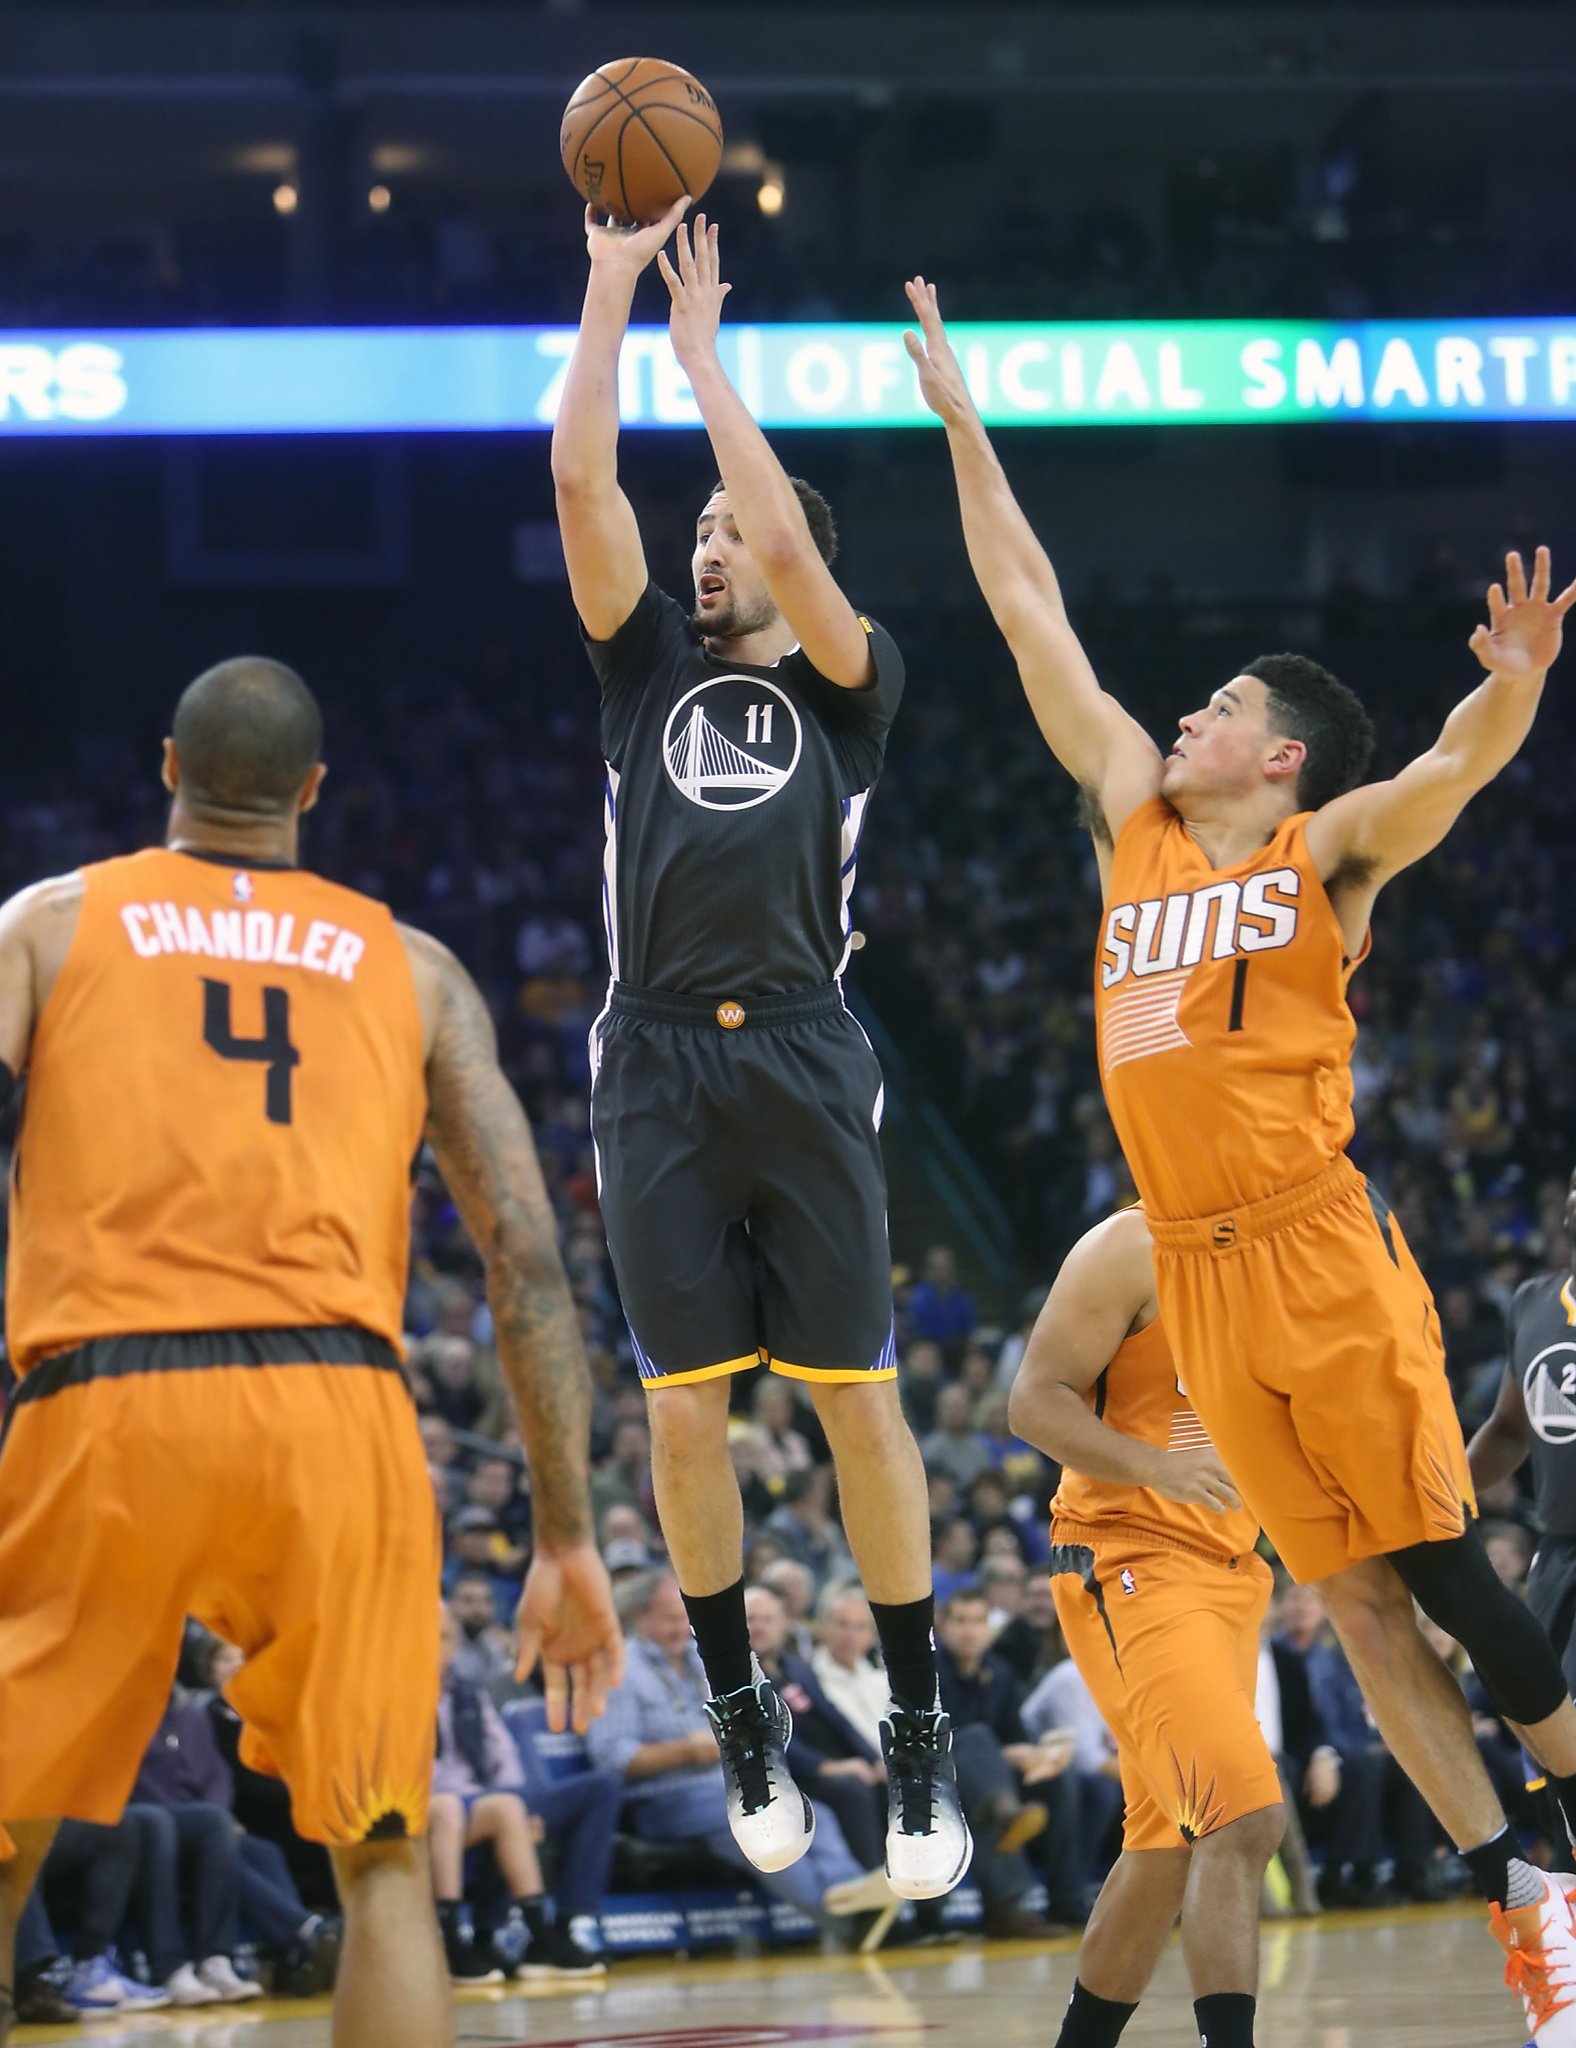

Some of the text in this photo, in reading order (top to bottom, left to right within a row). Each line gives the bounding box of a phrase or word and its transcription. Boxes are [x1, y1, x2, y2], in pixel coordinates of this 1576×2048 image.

[787, 340, 1206, 412] OFICIAL
[744, 704, 774, 743] 11
[120, 901, 365, 982] CHANDLER
[1228, 958, 1248, 1032] 1
[199, 975, 301, 1125] 4
